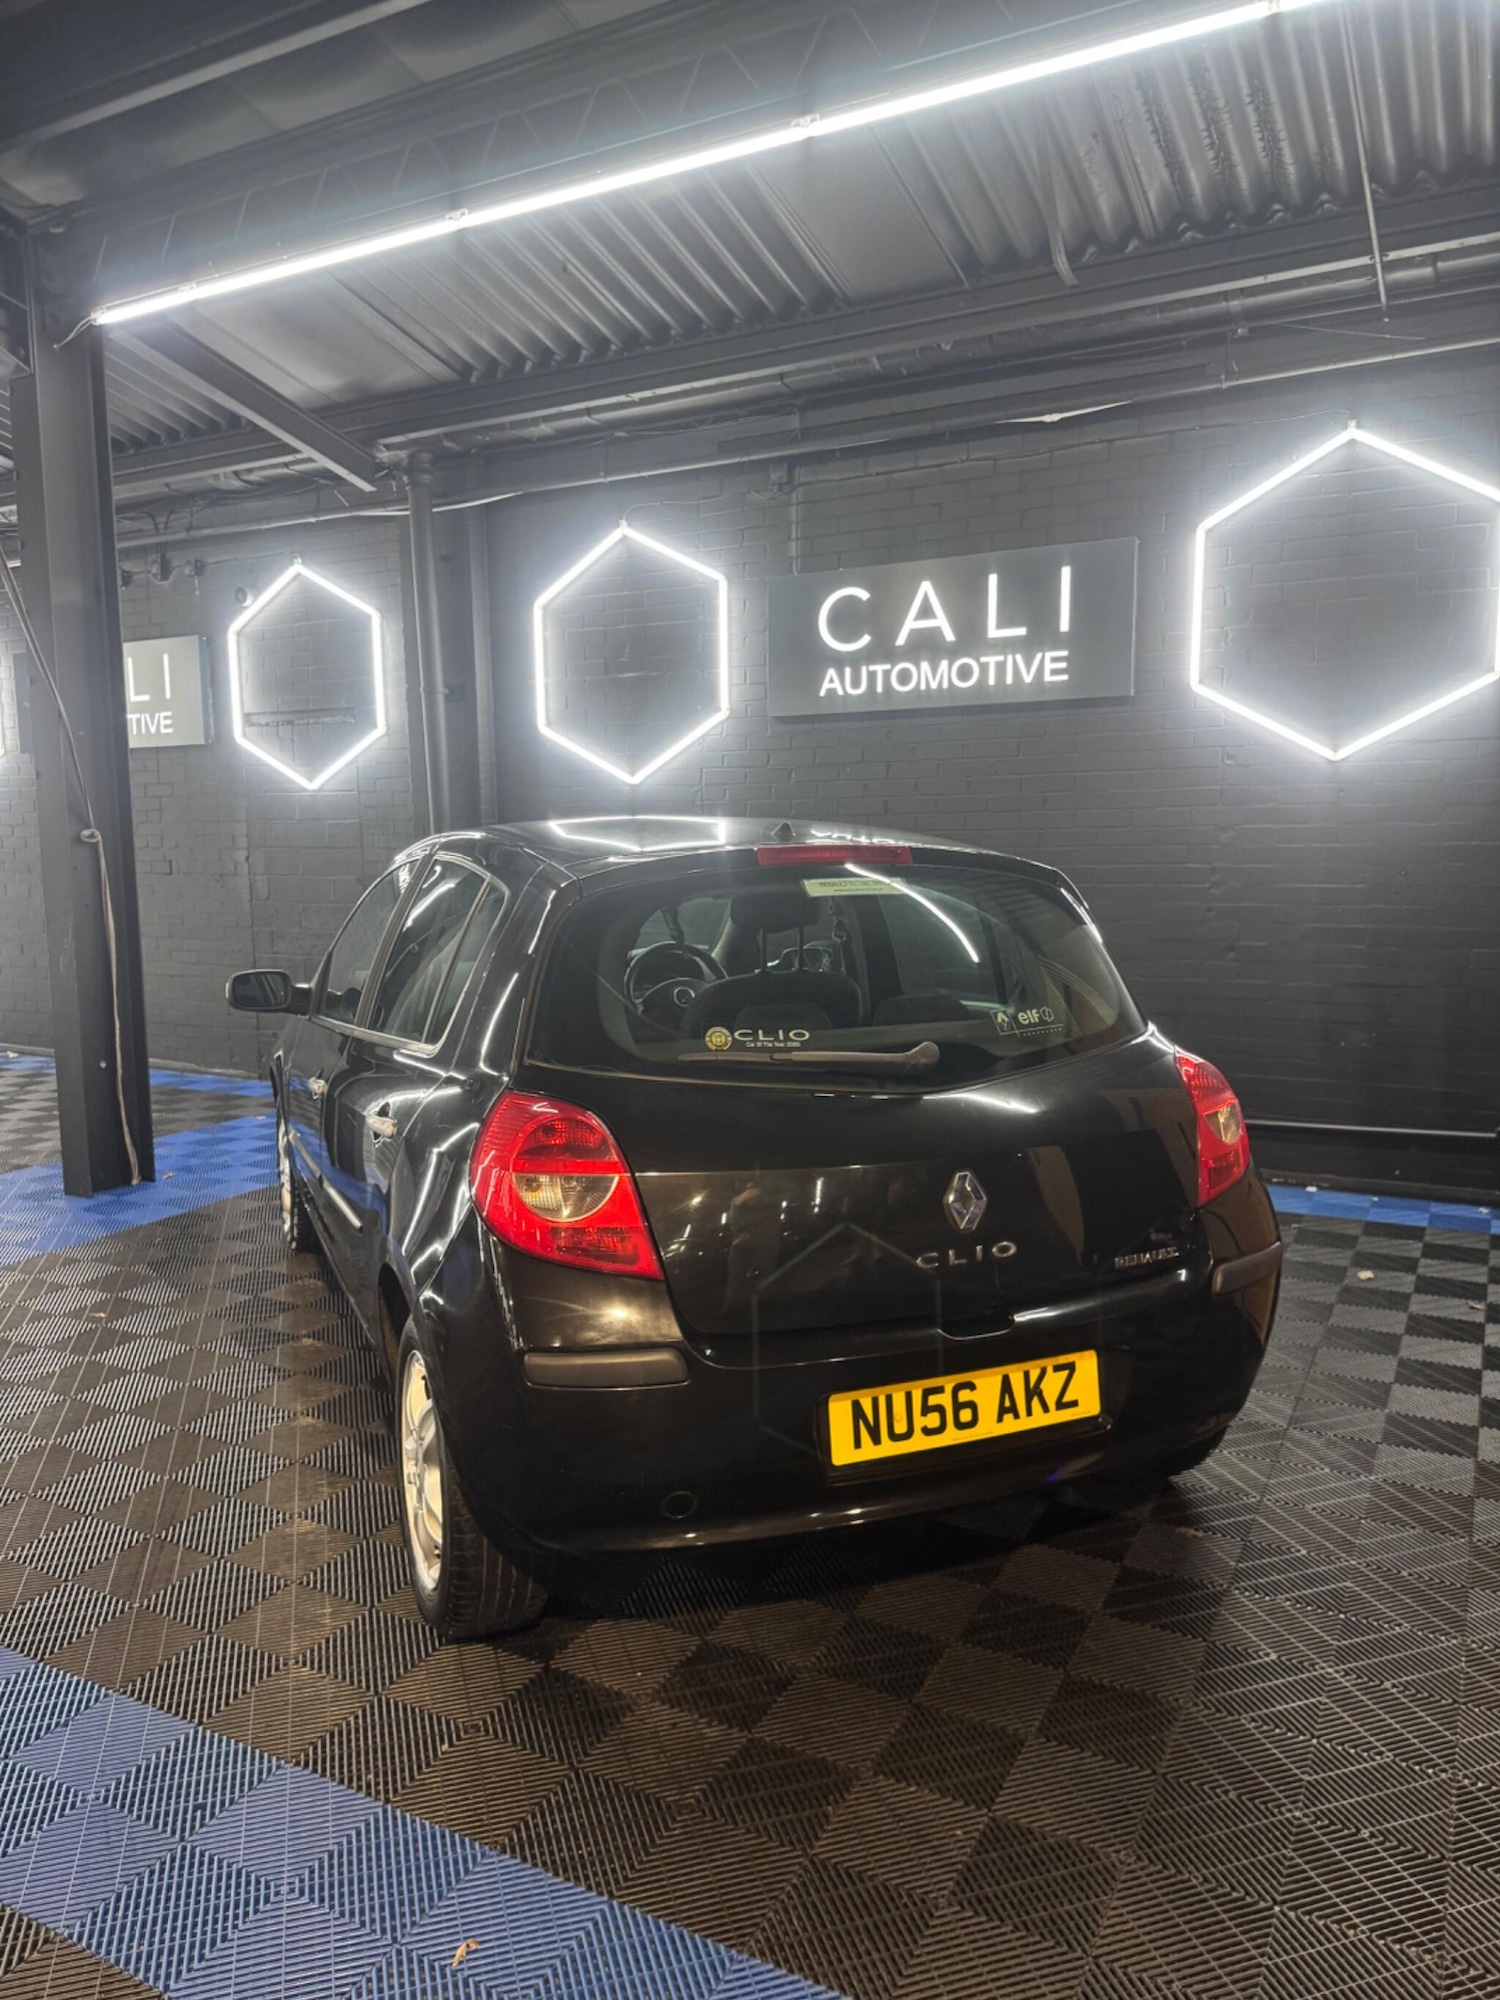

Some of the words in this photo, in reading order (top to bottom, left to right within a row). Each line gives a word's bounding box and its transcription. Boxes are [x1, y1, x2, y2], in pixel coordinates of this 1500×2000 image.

[818, 566, 1071, 652] CALI
[127, 653, 170, 702] LI
[818, 650, 1069, 697] AUTOMOTIVE
[126, 711, 173, 736] TIVE
[733, 1029, 810, 1041] CLIO
[1017, 1008, 1040, 1025] elf
[916, 1241, 1017, 1269] CLIO
[851, 1380, 979, 1451] NU56
[997, 1361, 1079, 1424] AKZ
